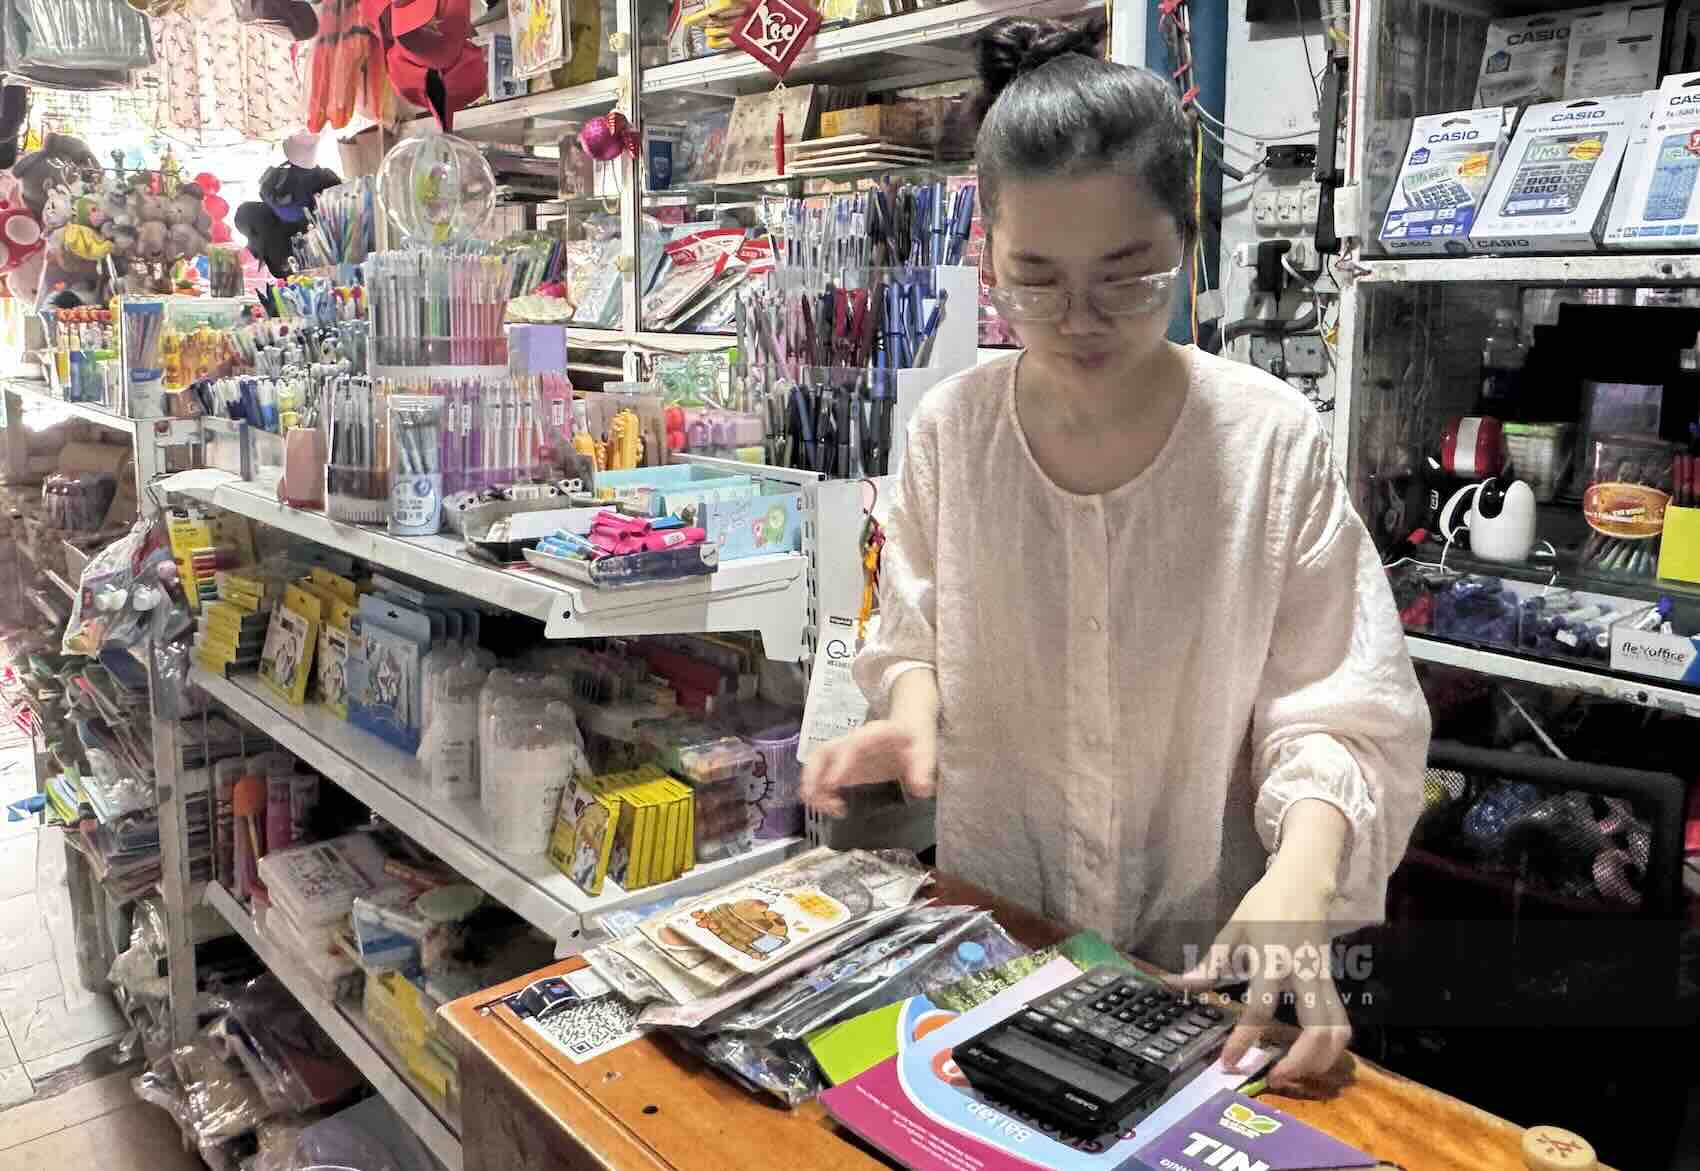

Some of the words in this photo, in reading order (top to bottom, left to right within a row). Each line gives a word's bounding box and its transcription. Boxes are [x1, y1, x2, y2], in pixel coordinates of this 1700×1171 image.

[1506, 27, 1571, 46] CASIO
[1551, 110, 1606, 122] CASIO
[1428, 130, 1479, 144] CASIO
[1477, 239, 1529, 248] CASIO
[1182, 1132, 1270, 1171] TIN
